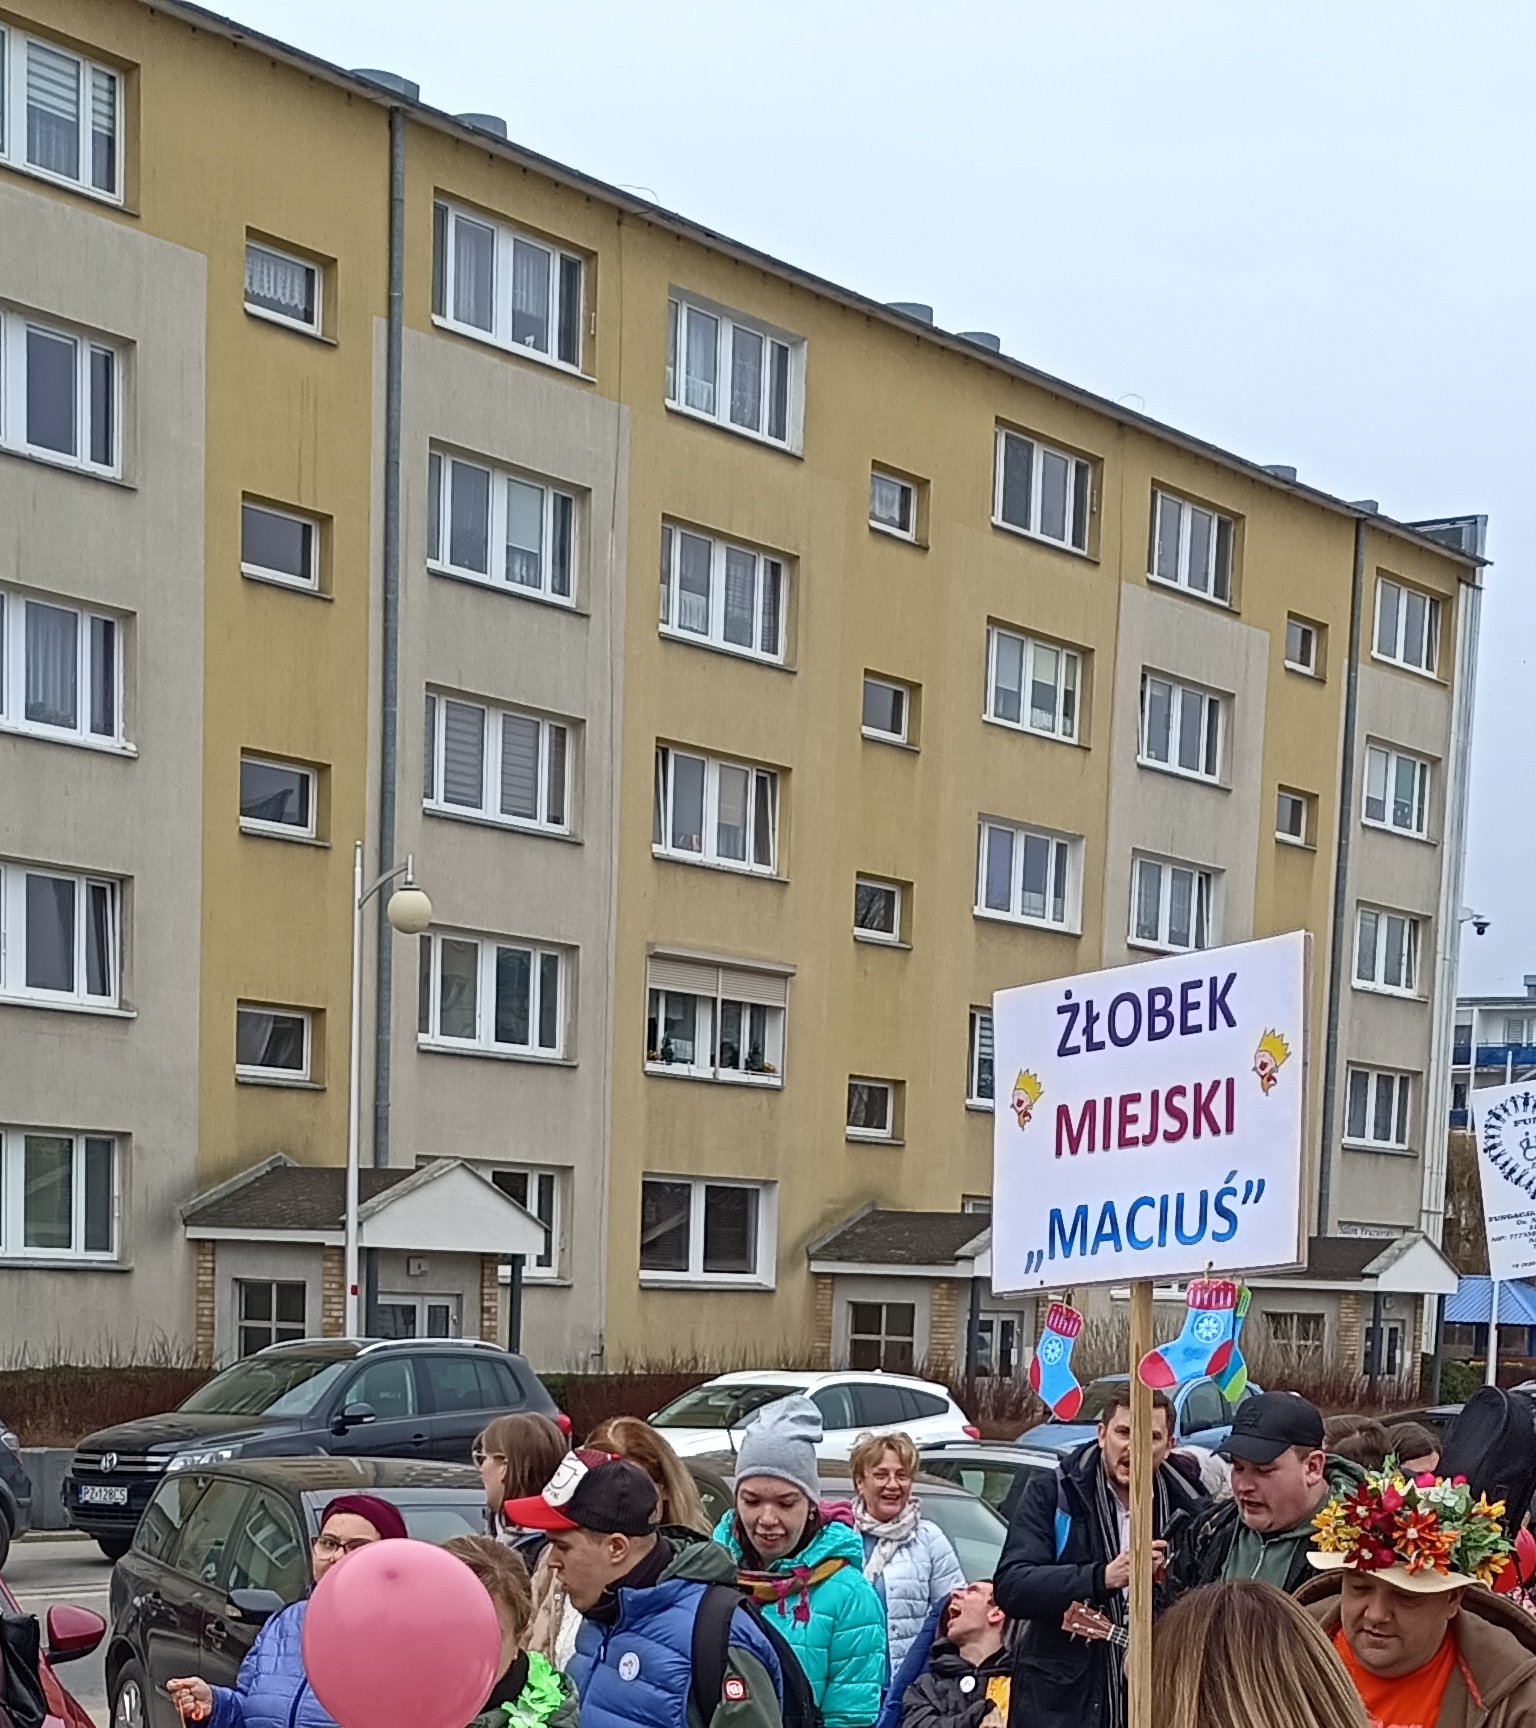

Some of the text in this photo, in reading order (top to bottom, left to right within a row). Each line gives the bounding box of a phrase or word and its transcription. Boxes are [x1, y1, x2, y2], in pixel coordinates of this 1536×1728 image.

[1056, 972, 1238, 1058] ŻŁOBEK
[1054, 1076, 1236, 1159] MIEJSKI
[1023, 1169, 1266, 1275] „MACIUŚ”
